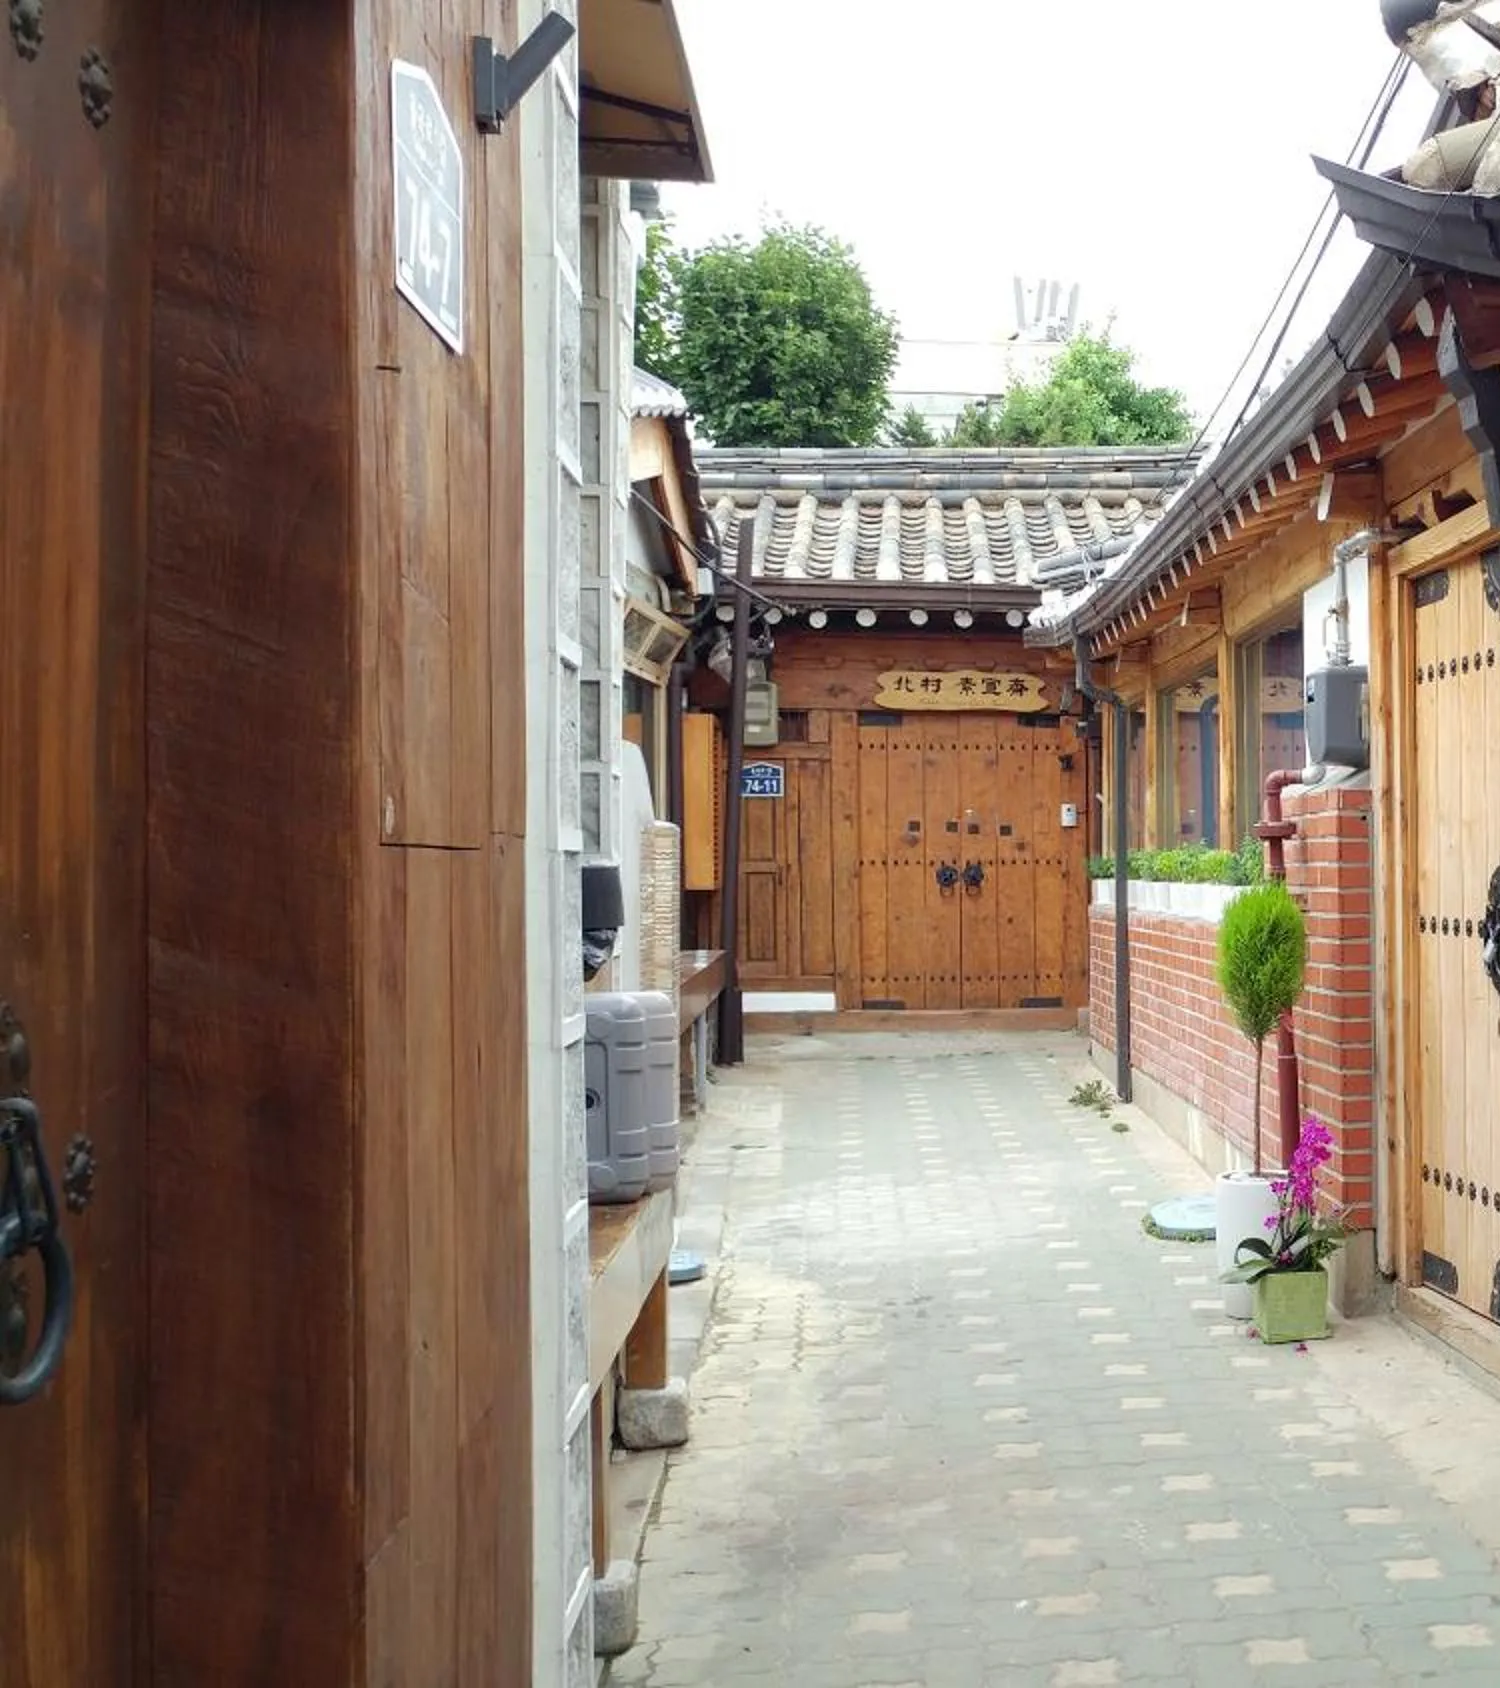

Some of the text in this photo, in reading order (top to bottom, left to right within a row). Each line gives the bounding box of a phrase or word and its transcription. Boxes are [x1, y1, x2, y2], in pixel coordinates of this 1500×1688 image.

[405, 174, 452, 305] 74-7
[894, 676, 942, 693] 北村
[744, 779, 777, 793] 74-11
